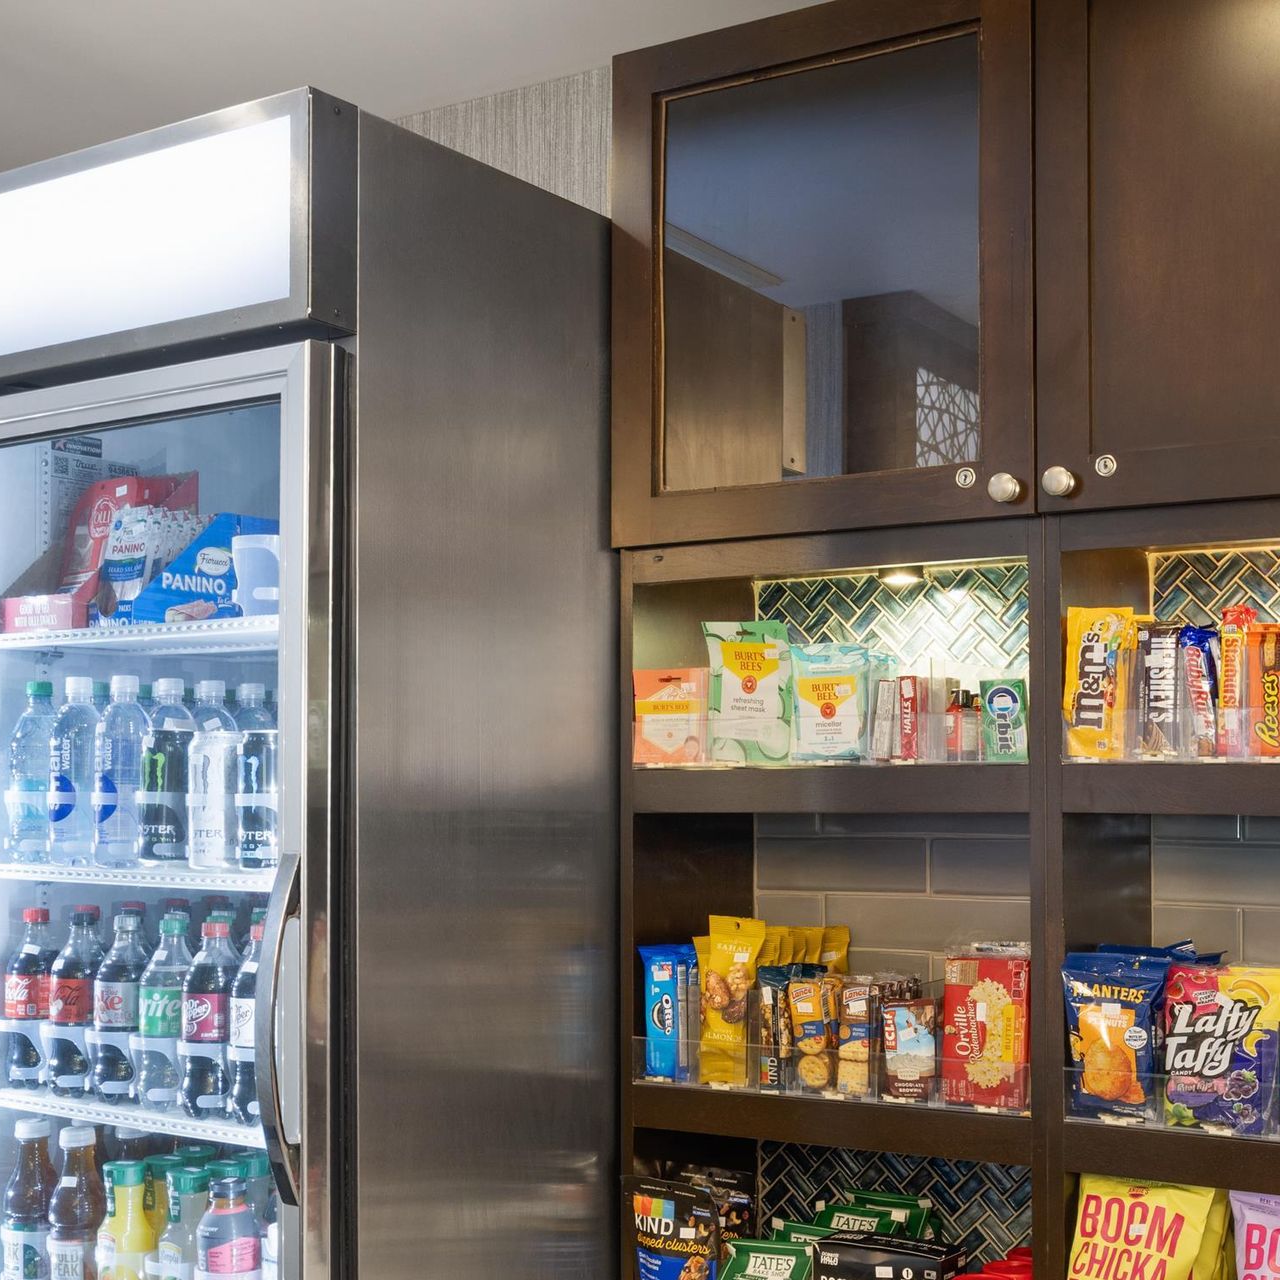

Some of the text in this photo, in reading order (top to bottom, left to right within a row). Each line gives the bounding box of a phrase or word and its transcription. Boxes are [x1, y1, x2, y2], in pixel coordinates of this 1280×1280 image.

[112, 543, 145, 554] PANINO
[199, 553, 228, 567] Fiorucci
[162, 572, 226, 595] PANINO
[734, 651, 766, 660] BURT'S
[740, 662, 762, 671] BEES
[817, 693, 839, 701] BEES
[903, 700, 912, 734] HALLS
[986, 686, 1021, 755] Orbit
[61, 736, 71, 770] water
[104, 737, 112, 770] water
[792, 987, 813, 999] Lance
[845, 989, 869, 1000] Lance
[140, 993, 180, 1017] rite
[661, 993, 673, 1035] OREO
[1174, 995, 1258, 1041] Laffy
[954, 1005, 970, 1056] Orville
[1165, 1036, 1234, 1076] Taffy
[635, 1214, 673, 1236] KIND
[835, 1215, 876, 1231] TATE'S
[1080, 1194, 1185, 1258] BOOM
[665, 1237, 710, 1255] clusters
[752, 1255, 793, 1271] TATE'S
